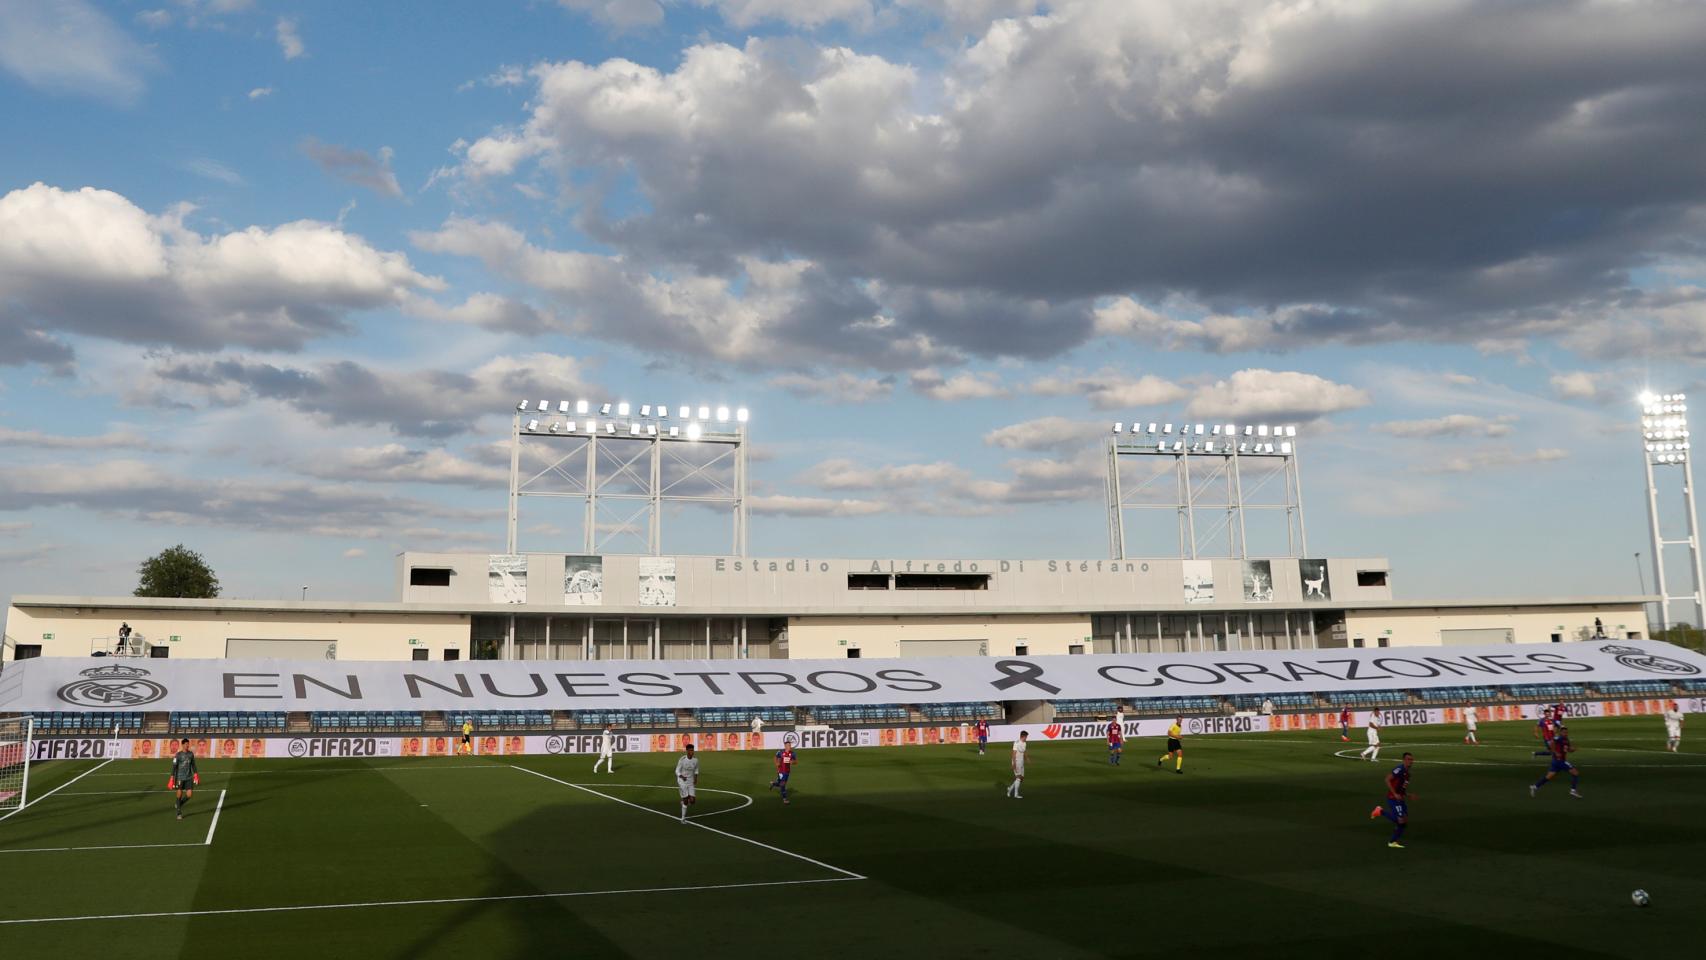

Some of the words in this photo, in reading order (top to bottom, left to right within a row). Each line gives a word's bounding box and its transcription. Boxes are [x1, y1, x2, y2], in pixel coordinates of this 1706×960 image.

[715, 558, 829, 572] Estadio
[870, 559, 978, 573] Alfredo
[1000, 560, 1024, 573] Di
[1048, 560, 1150, 573] Stéfano
[222, 672, 363, 700] EN
[403, 669, 943, 699] NUESTROS
[1097, 653, 1595, 688] CORAZONES
